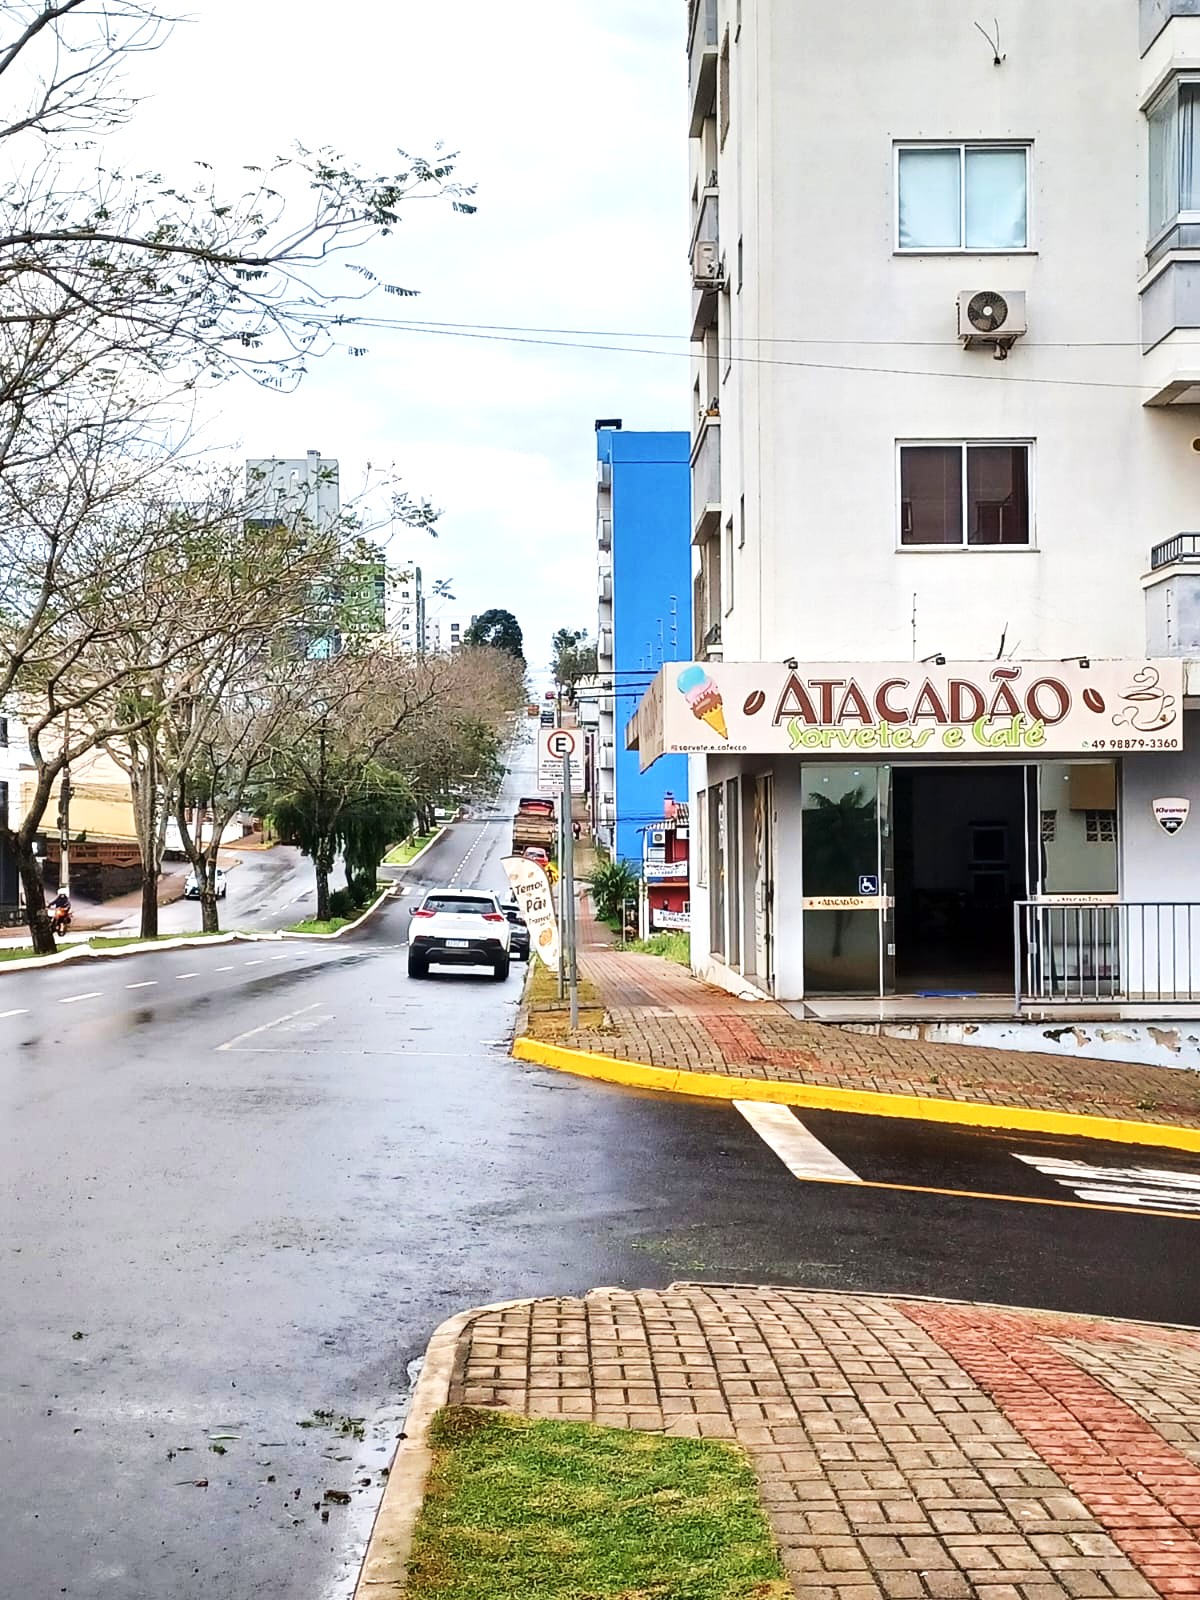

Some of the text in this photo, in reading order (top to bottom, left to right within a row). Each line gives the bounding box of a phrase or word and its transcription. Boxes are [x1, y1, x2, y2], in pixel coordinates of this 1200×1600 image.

[772, 667, 1072, 726] ATACADÃO
[787, 713, 1047, 749] Sorvetes e Café
[1091, 738, 1178, 749] 49 98879-3360
[556, 737, 567, 752] E
